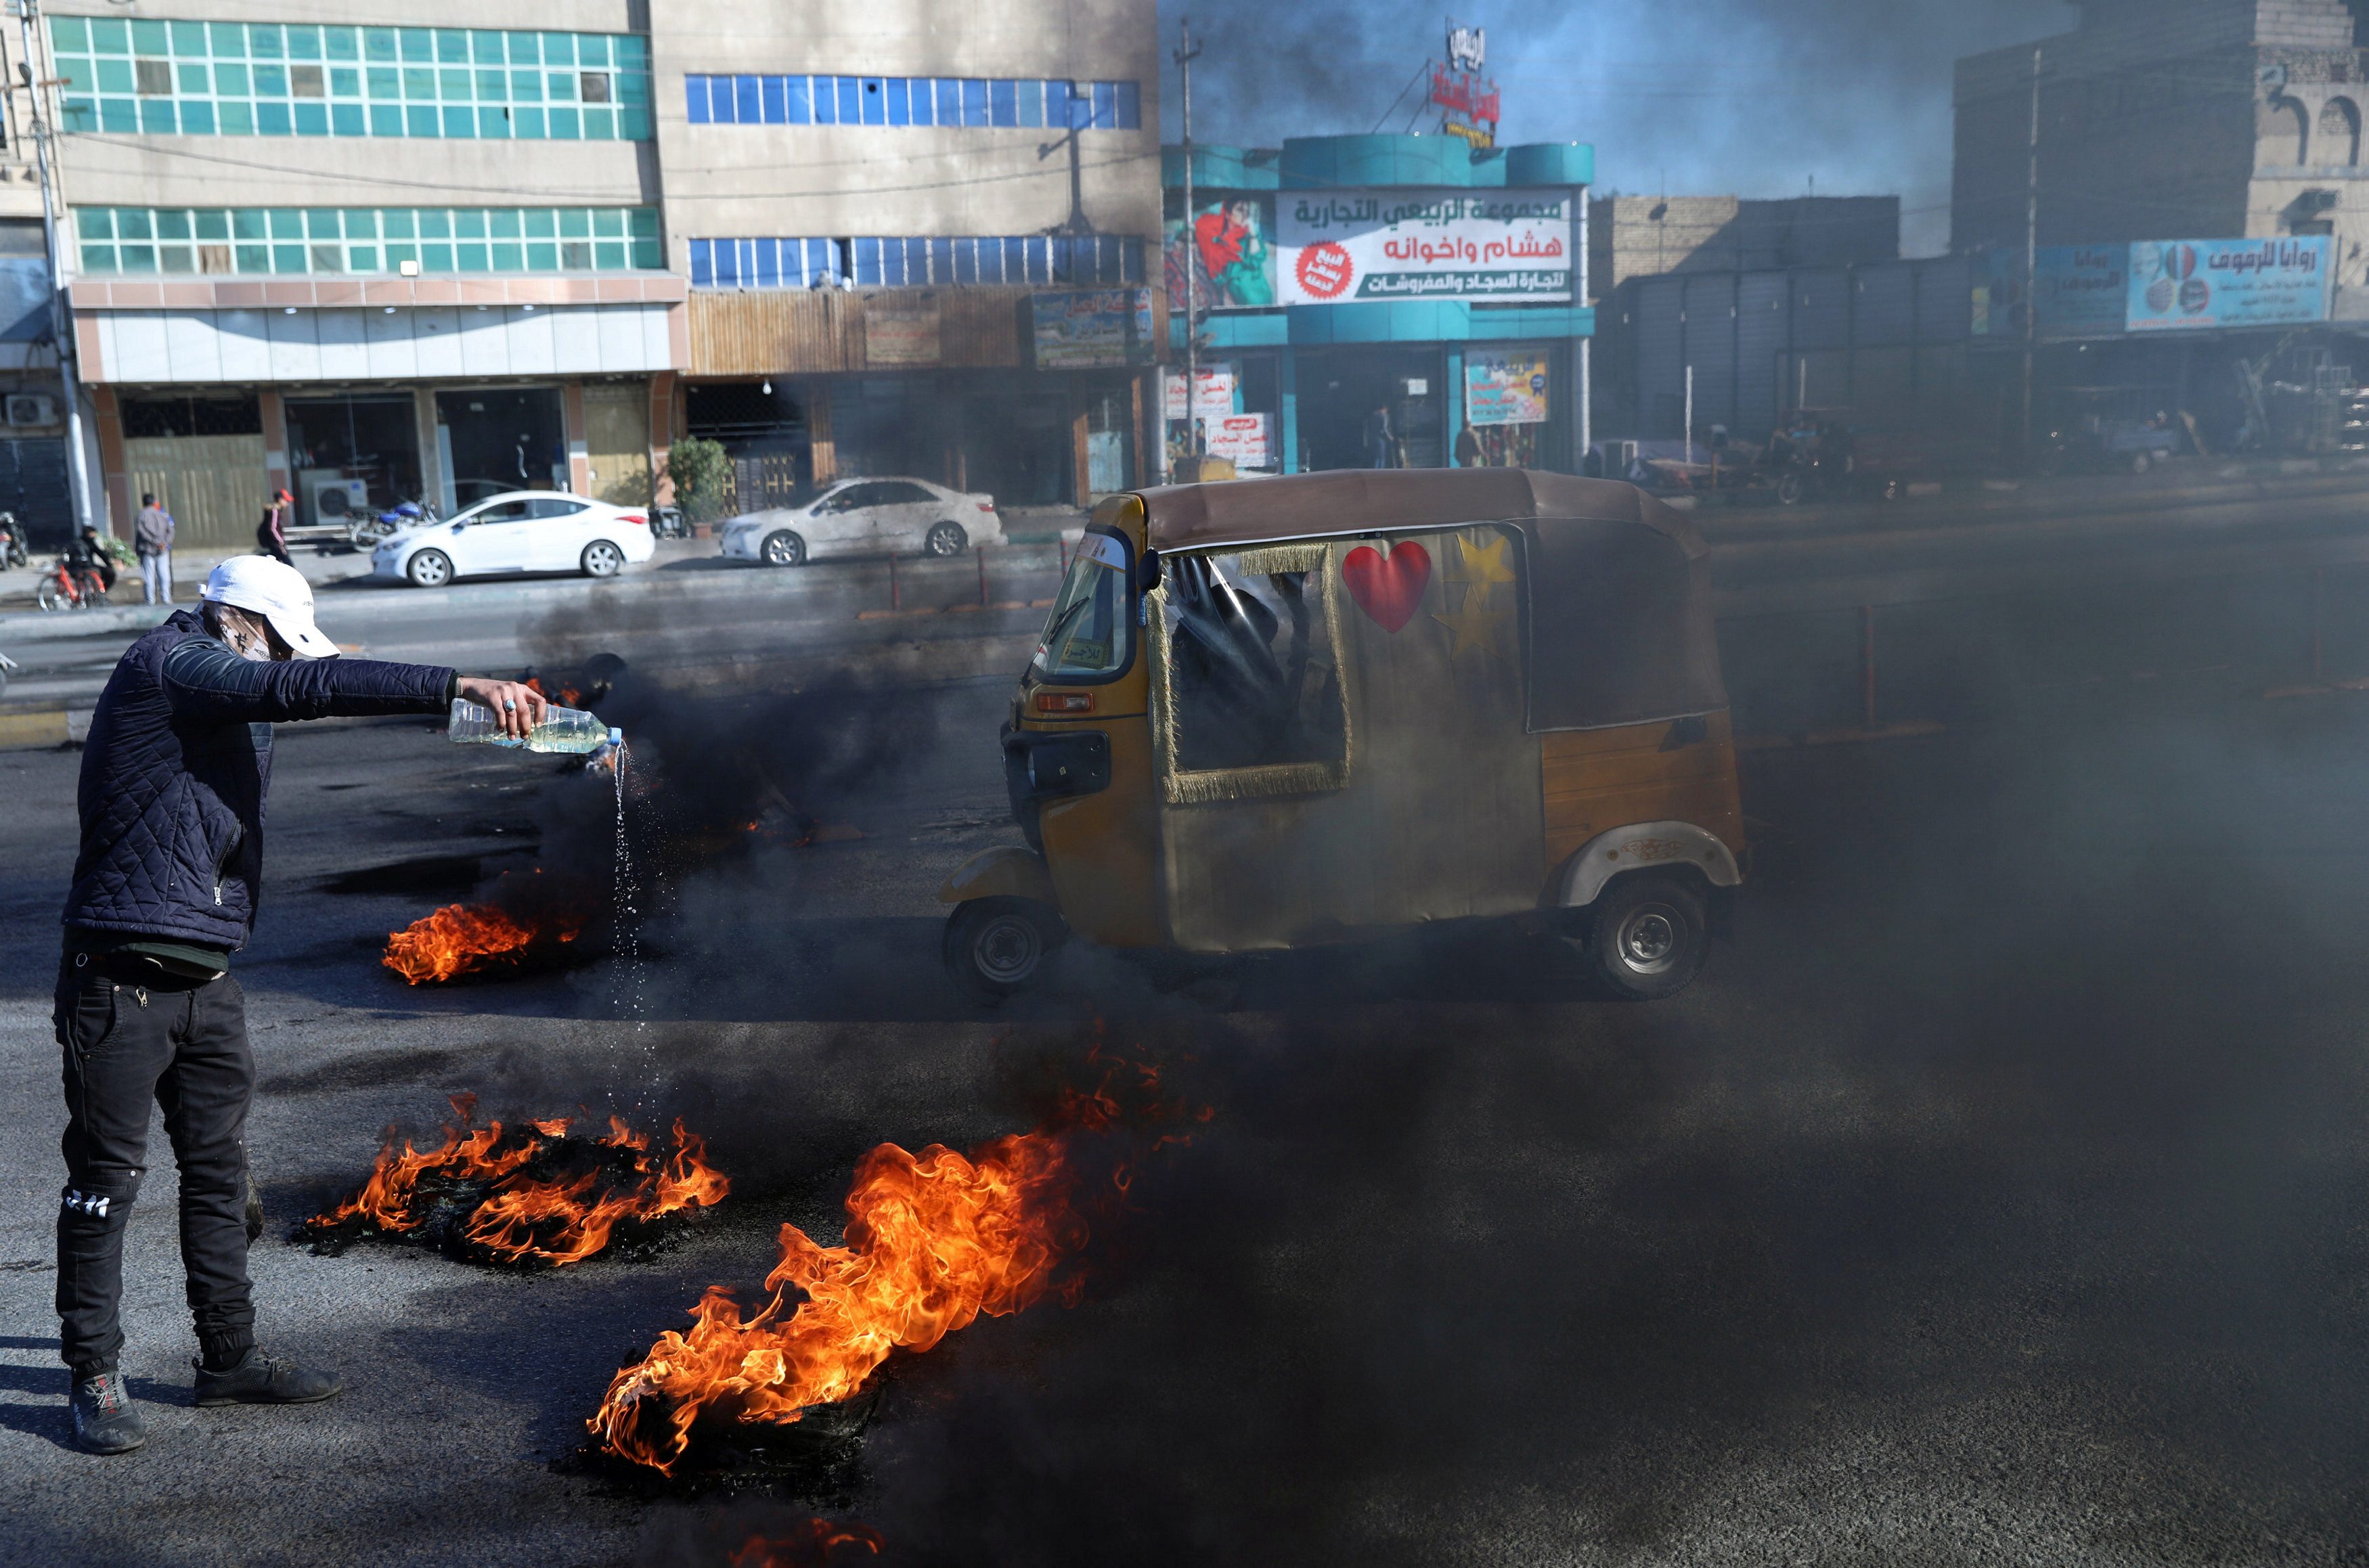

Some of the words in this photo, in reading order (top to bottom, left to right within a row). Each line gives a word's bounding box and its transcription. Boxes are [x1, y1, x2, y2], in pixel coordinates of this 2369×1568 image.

[1294, 200, 1378, 229] التجارية
[1383, 198, 1467, 231] الربيعي
[1471, 198, 1562, 225] مجموعة
[1384, 237, 1478, 264] واخوانه
[1484, 230, 1563, 263] هشام
[2208, 242, 2275, 274] للرفوف
[2280, 241, 2318, 271] زوايا
[1368, 274, 1463, 294] والمفروشات
[1465, 273, 1518, 290] السجاد
[1518, 271, 1565, 290] لتجارة
